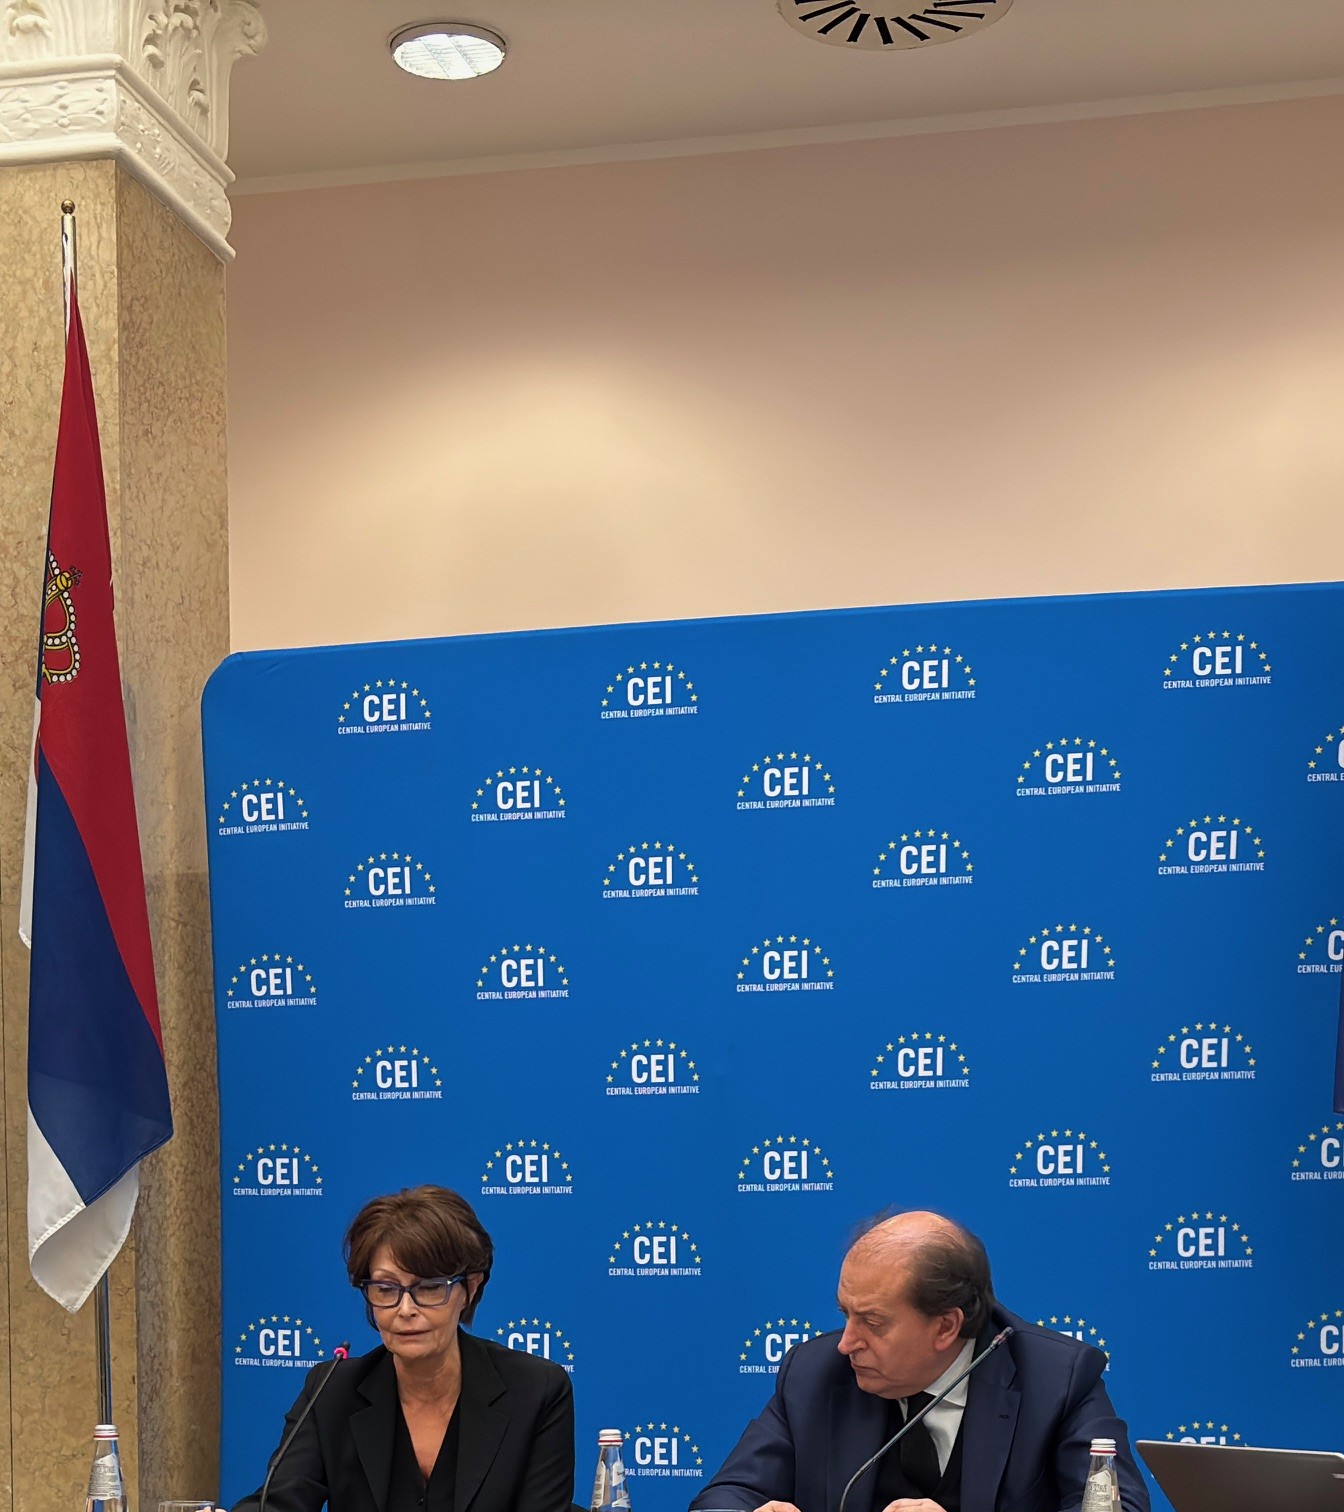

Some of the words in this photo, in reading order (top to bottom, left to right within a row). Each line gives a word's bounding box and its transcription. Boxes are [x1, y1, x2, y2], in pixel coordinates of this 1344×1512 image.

[1192, 646, 1243, 675] CEI
[901, 660, 949, 690] CEI
[1162, 678, 1194, 688] CENTRAL
[1194, 676, 1234, 687] EUROPEAN
[1235, 675, 1271, 685] INITIATIVE
[627, 676, 672, 706] CEI
[873, 692, 904, 703] CENTRAL
[903, 691, 941, 702] EUROPEAN
[941, 689, 976, 700] INITIATIVE
[363, 693, 406, 722] CEI
[600, 708, 629, 718] CENTRAL
[629, 706, 665, 717] EUROPEAN
[665, 705, 698, 715] INITIATIVE
[337, 724, 365, 734] CENTRAL
[365, 722, 399, 733] EUROPEAN
[400, 721, 431, 731] INITIATIVE
[1045, 753, 1094, 782] CEI
[763, 767, 809, 797] CEI
[1307, 773, 1338, 782] CENTRAL
[496, 781, 540, 809] CEI
[1015, 785, 1047, 796] CENTRAL
[1047, 784, 1085, 794] EUROPEAN
[1086, 782, 1121, 793] INITIATIVE
[242, 793, 284, 822] CEI
[736, 799, 765, 809] CENTRAL
[765, 798, 801, 808] EUROPEAN
[802, 796, 835, 807] INITIATIVE
[471, 812, 499, 821] CENTRAL
[499, 810, 533, 820] EUROPEAN
[534, 809, 565, 819] INITIATIVE
[218, 824, 245, 835] CENTRAL
[245, 822, 278, 833] EUROPEAN
[278, 820, 309, 831] INITIATIVE
[1188, 831, 1238, 861] CEI
[900, 845, 947, 874] CEI
[628, 857, 673, 885] CEI
[1157, 864, 1189, 874] CENTRAL
[1189, 862, 1228, 873] EUROPEAN
[1229, 861, 1265, 872] INITIATIVE
[368, 867, 411, 895] CEI
[871, 877, 902, 888] CENTRAL
[901, 876, 938, 886] EUROPEAN
[939, 874, 973, 885] INITIATIVE
[602, 888, 631, 898] CENTRAL
[630, 887, 666, 897] EUROPEAN
[666, 886, 699, 896] INITIATIVE
[343, 898, 371, 908] CENTRAL
[371, 896, 405, 907] EUROPEAN
[405, 895, 436, 905] INITIATIVE
[1040, 939, 1088, 970] CEI
[763, 950, 808, 979] CEI
[1297, 964, 1328, 973] CENTRAL
[501, 959, 544, 987] CEI
[1011, 972, 1042, 983] CENTRAL
[1042, 971, 1079, 982] EUROPEAN
[1080, 970, 1115, 981] INITIATIVE
[250, 968, 293, 996] CEI
[735, 982, 765, 992] CENTRAL
[765, 981, 800, 991] EUROPEAN
[801, 980, 834, 990] INITIATIVE
[475, 990, 504, 999] CENTRAL
[503, 989, 537, 999] EUROPEAN
[538, 988, 569, 998] INITIATIVE
[227, 998, 254, 1008] CENTRAL
[253, 997, 286, 1007] EUROPEAN
[286, 996, 317, 1006] INITIATIVE
[1180, 1038, 1229, 1068] CEI
[631, 1054, 675, 1083] CEI
[897, 1047, 943, 1077] CEI
[376, 1060, 418, 1088] CEI
[1150, 1071, 1181, 1081] CENTRAL
[1181, 1070, 1219, 1080] EUROPEAN
[1220, 1069, 1255, 1079] INITIATIVE
[605, 1085, 634, 1095] CENTRAL
[633, 1085, 667, 1094] EUROPEAN
[668, 1085, 699, 1094] INITIATIVE
[869, 1079, 899, 1089] CENTRAL
[899, 1078, 935, 1089] EUROPEAN
[936, 1078, 969, 1088] INITIATIVE
[351, 1090, 379, 1100] CENTRAL
[378, 1090, 411, 1099] EUROPEAN
[412, 1089, 442, 1099] INITIATIVE
[763, 1151, 808, 1180] CEI
[1036, 1145, 1084, 1174] CEI
[257, 1158, 299, 1184] CEI
[505, 1155, 548, 1183] CEI
[1291, 1171, 1322, 1181] CENTRAL
[737, 1182, 766, 1192] CENTRAL
[765, 1182, 800, 1191] EUROPEAN
[801, 1181, 833, 1191] INITIATIVE
[1008, 1177, 1039, 1187] CENTRAL
[1038, 1176, 1075, 1186] EUROPEAN
[1076, 1176, 1110, 1186] INITIATIVE
[232, 1186, 260, 1195] CENTRAL
[259, 1187, 292, 1195] EUROPEAN
[292, 1187, 323, 1195] INITIATIVE
[481, 1185, 508, 1194] CENTRAL
[507, 1185, 541, 1194] EUROPEAN
[542, 1185, 573, 1194] INITIATIVE
[1177, 1227, 1225, 1257] CEI
[633, 1236, 677, 1264] CEI
[1148, 1259, 1179, 1269] CENTRAL
[1179, 1259, 1217, 1269] EUROPEAN
[1218, 1258, 1253, 1268] INITIATIVE
[607, 1267, 636, 1275] CENTRAL
[635, 1267, 669, 1275] EUROPEAN
[670, 1267, 701, 1275] INITIATIVE
[259, 1328, 301, 1357] CEI
[234, 1357, 261, 1366] CENTRAL
[262, 1358, 294, 1368] EUROPEAN
[1290, 1356, 1322, 1367] CENTRAL
[739, 1365, 767, 1374] CENTRAL
[634, 1437, 678, 1465] CEI
[637, 1468, 670, 1477] EUROPEAN
[672, 1468, 703, 1477] INITIATIVE
